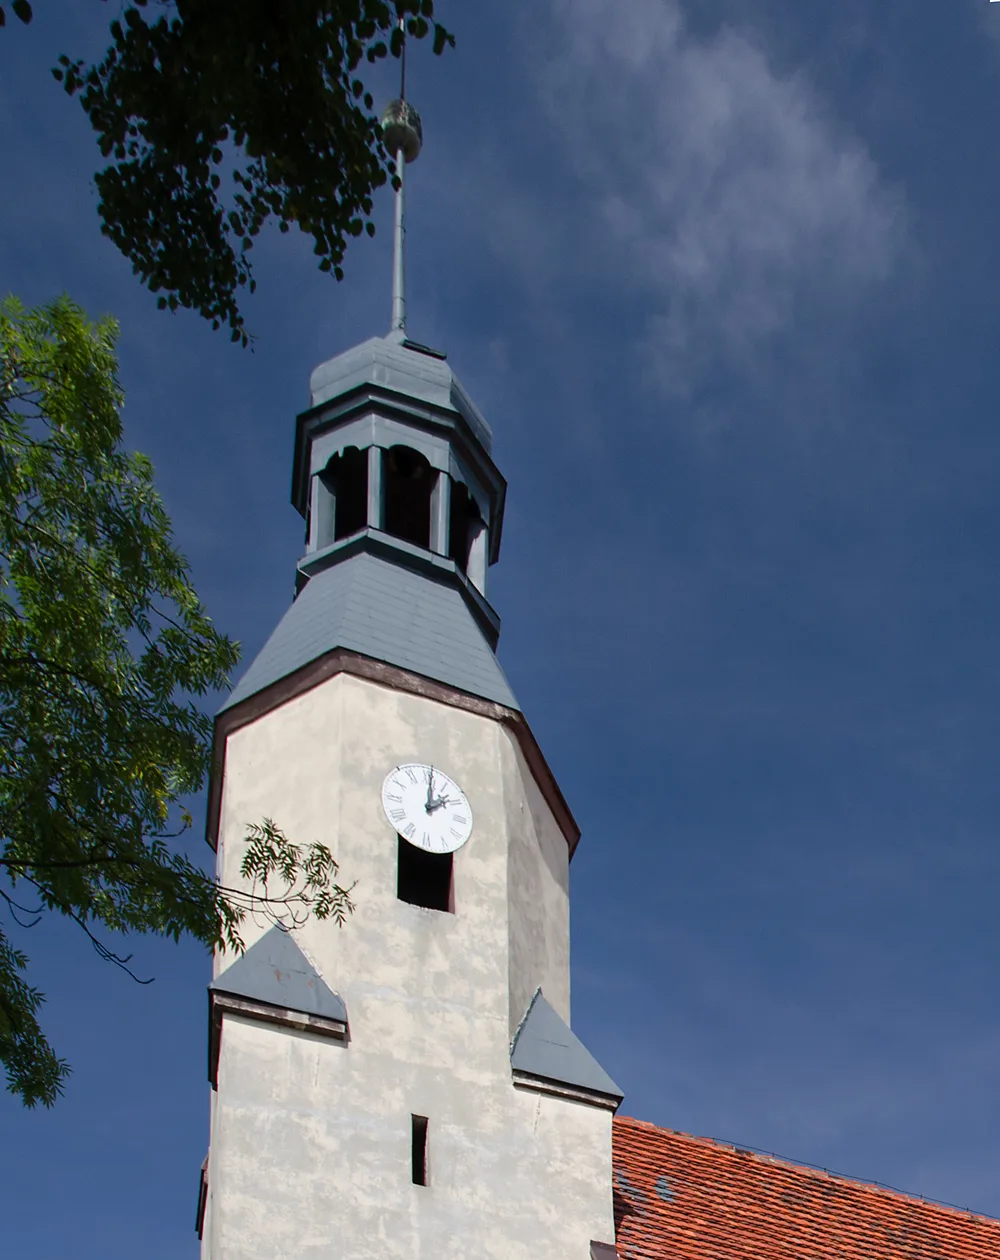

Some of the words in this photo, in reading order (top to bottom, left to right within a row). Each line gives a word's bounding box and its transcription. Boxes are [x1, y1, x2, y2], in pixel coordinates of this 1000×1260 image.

[392, 778, 406, 791] X
[390, 808, 407, 823] VIII
[453, 814, 467, 824] III
